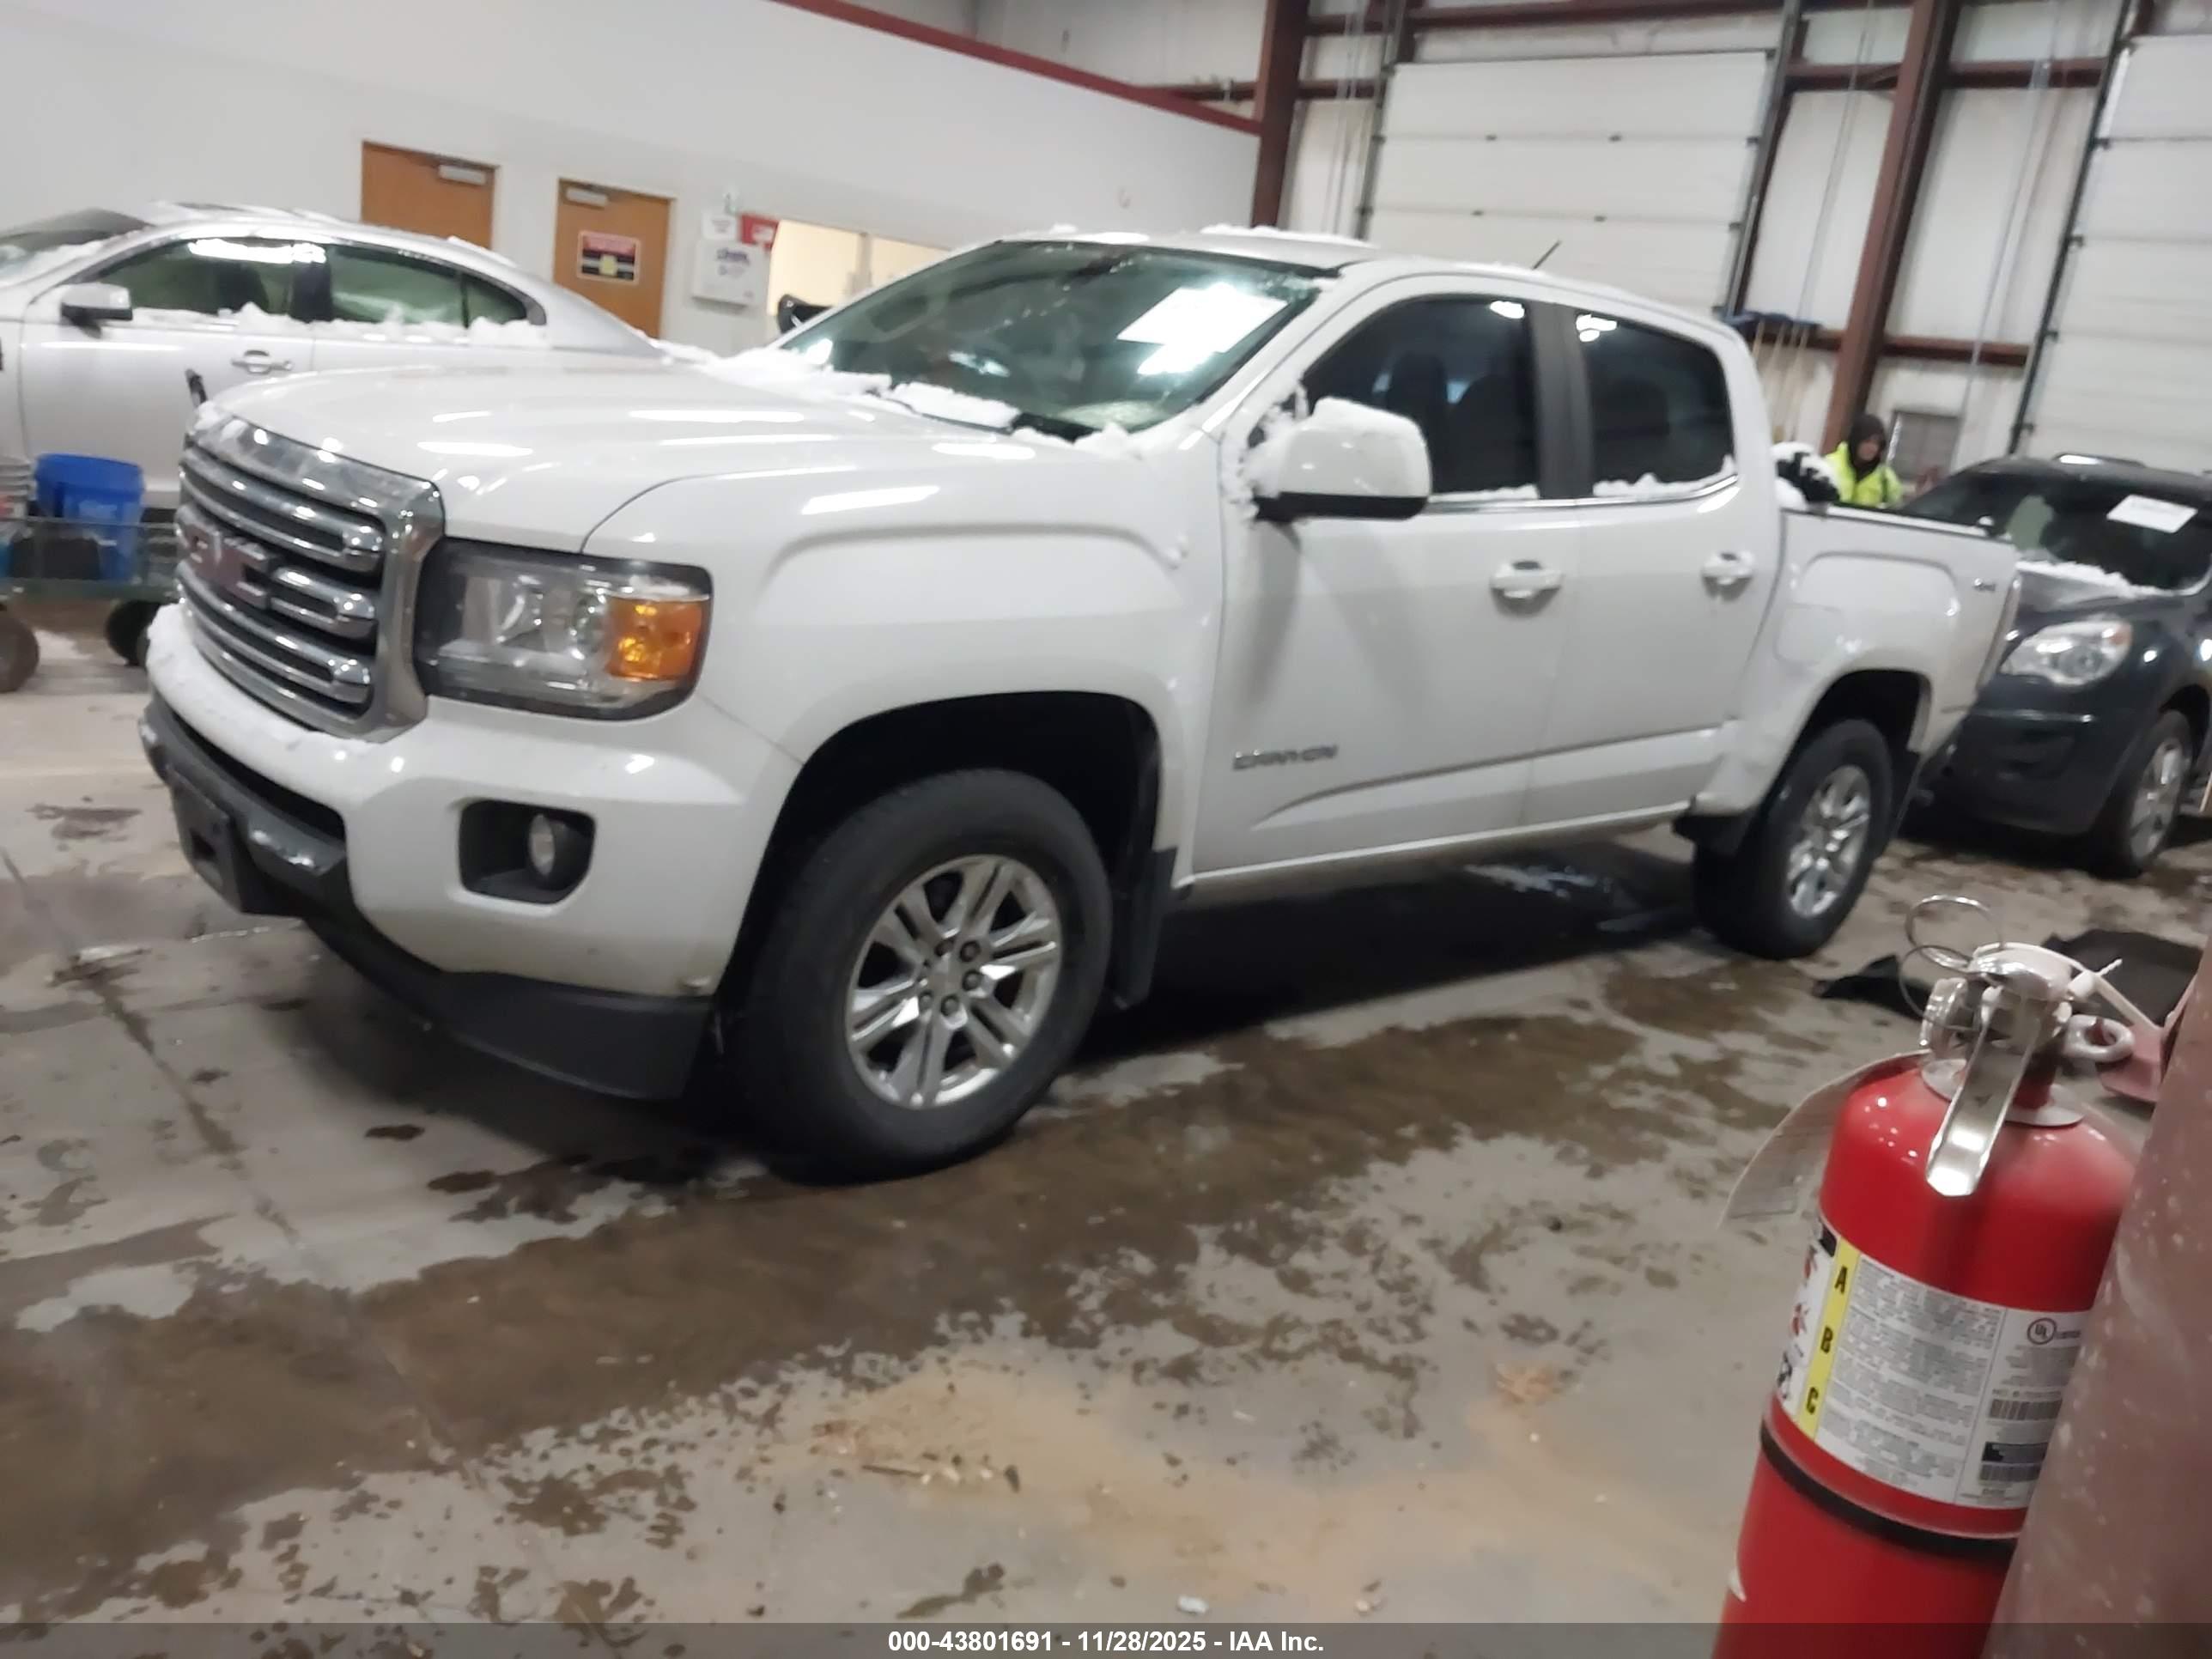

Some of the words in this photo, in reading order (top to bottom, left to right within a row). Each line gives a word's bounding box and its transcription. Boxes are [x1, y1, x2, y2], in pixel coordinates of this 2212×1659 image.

[1834, 1266, 1848, 1295] A
[1820, 1325, 1834, 1354] B
[1806, 1387, 1820, 1414] C
